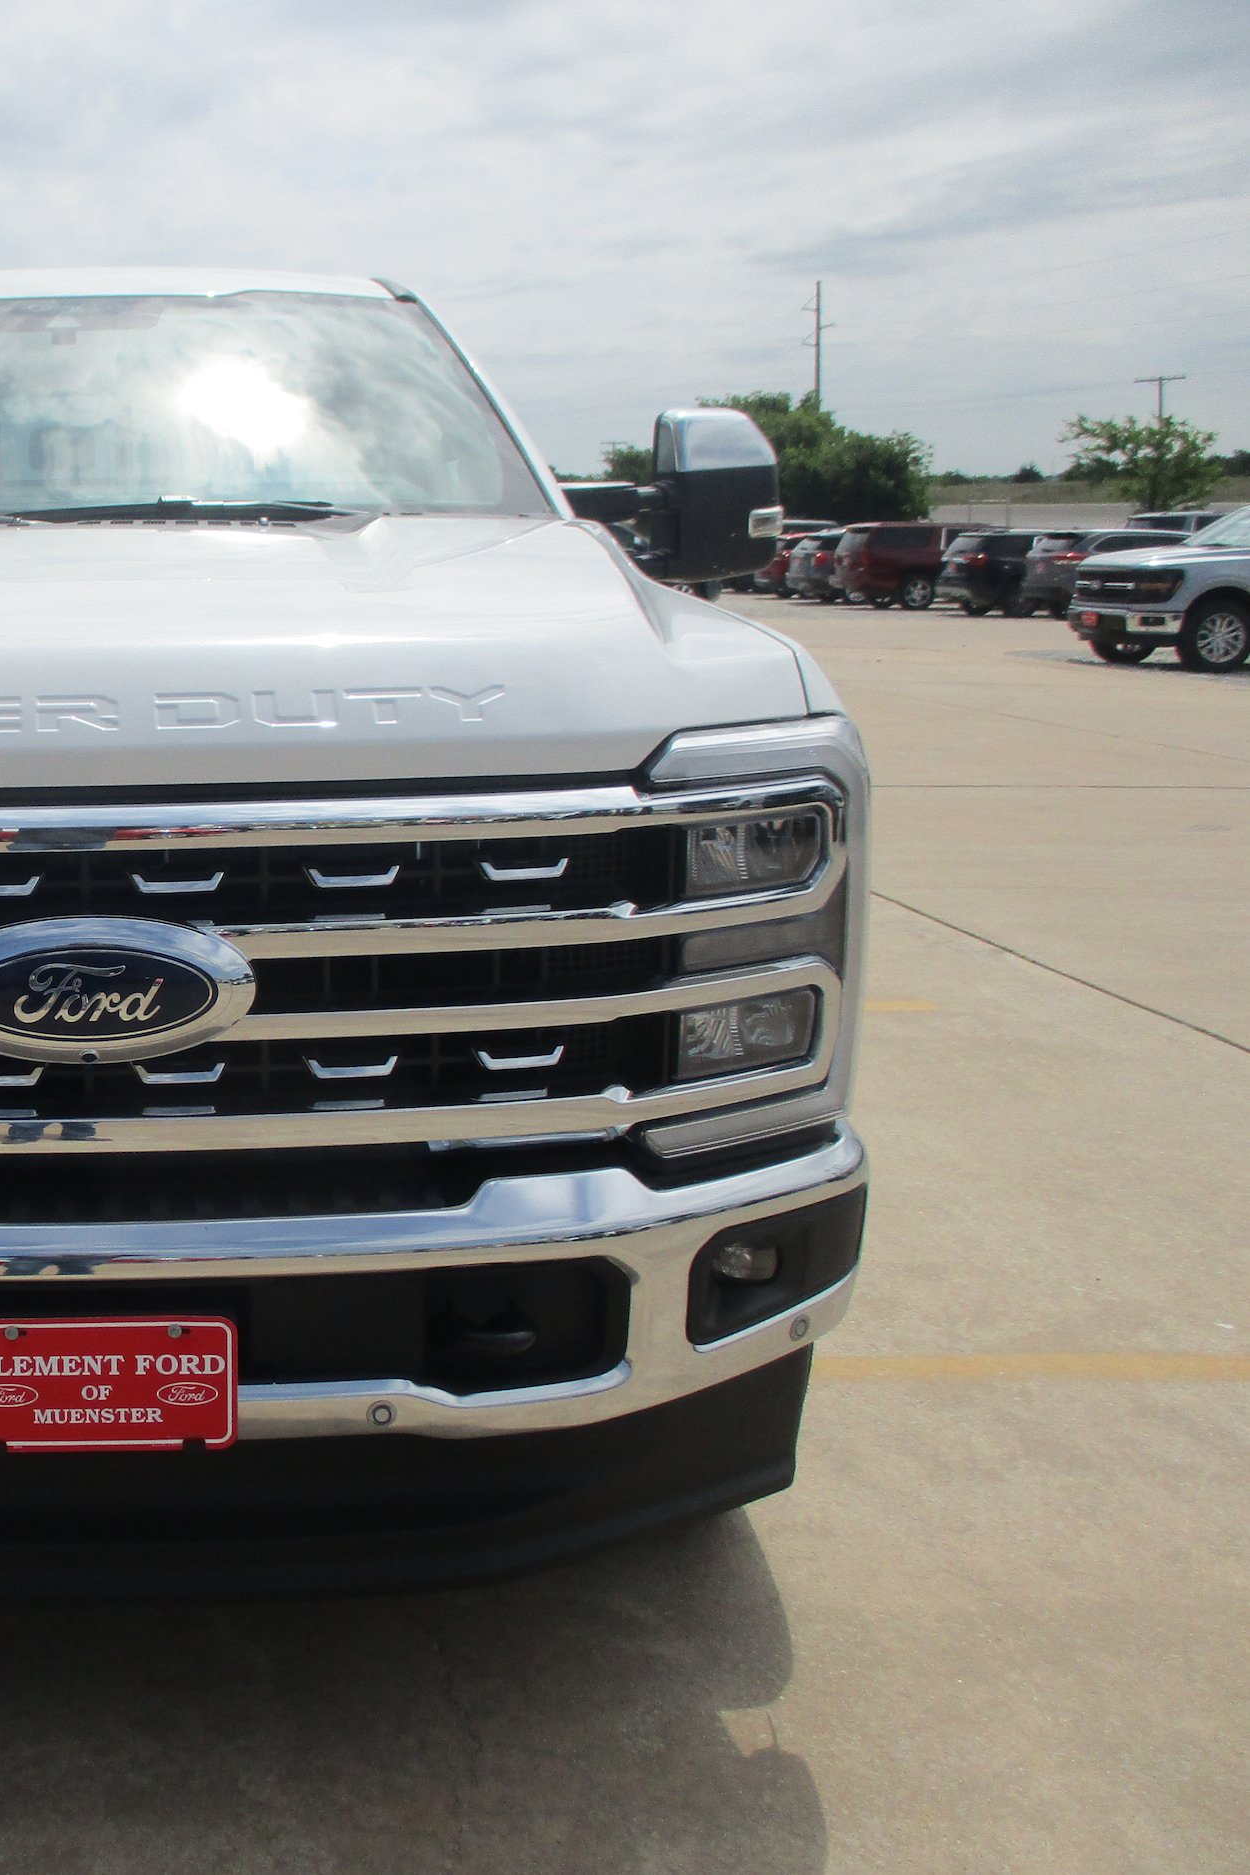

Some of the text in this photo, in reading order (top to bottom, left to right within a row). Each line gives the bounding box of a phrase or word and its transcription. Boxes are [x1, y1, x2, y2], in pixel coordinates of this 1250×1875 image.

[154, 684, 506, 730] DUTY
[13, 962, 165, 1024] Ford
[135, 1354, 226, 1376] FORD
[81, 1385, 113, 1401] OF
[166, 1382, 206, 1402] Ford
[32, 1408, 164, 1425] MUENSTER
